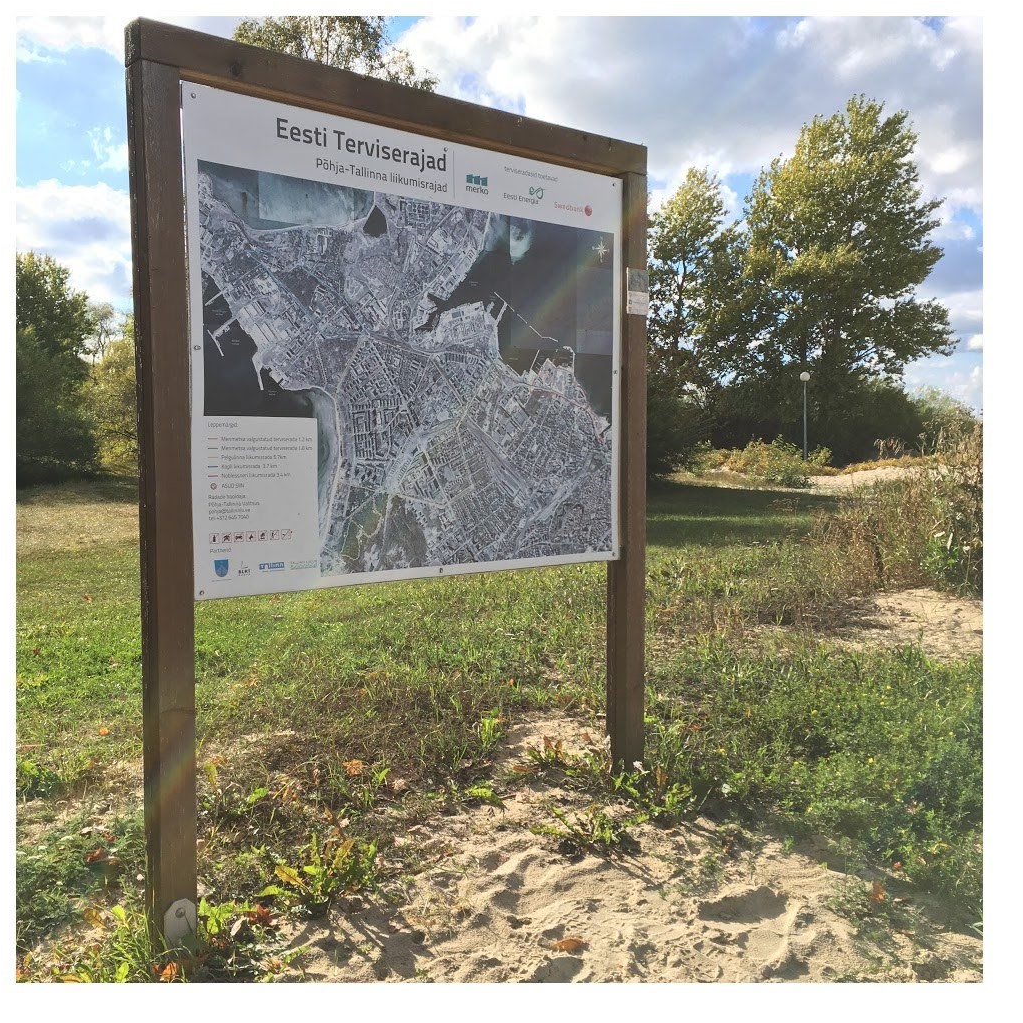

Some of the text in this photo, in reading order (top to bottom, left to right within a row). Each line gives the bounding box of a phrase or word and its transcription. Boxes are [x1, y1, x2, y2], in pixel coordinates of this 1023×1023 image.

[276, 117, 448, 172] Eesti Terviserajad
[315, 157, 448, 194] Põhja-Tallinna liikumisrajad
[465, 185, 489, 195] merko
[503, 192, 539, 205] Eesti Energia
[553, 201, 584, 213] Swedbank
